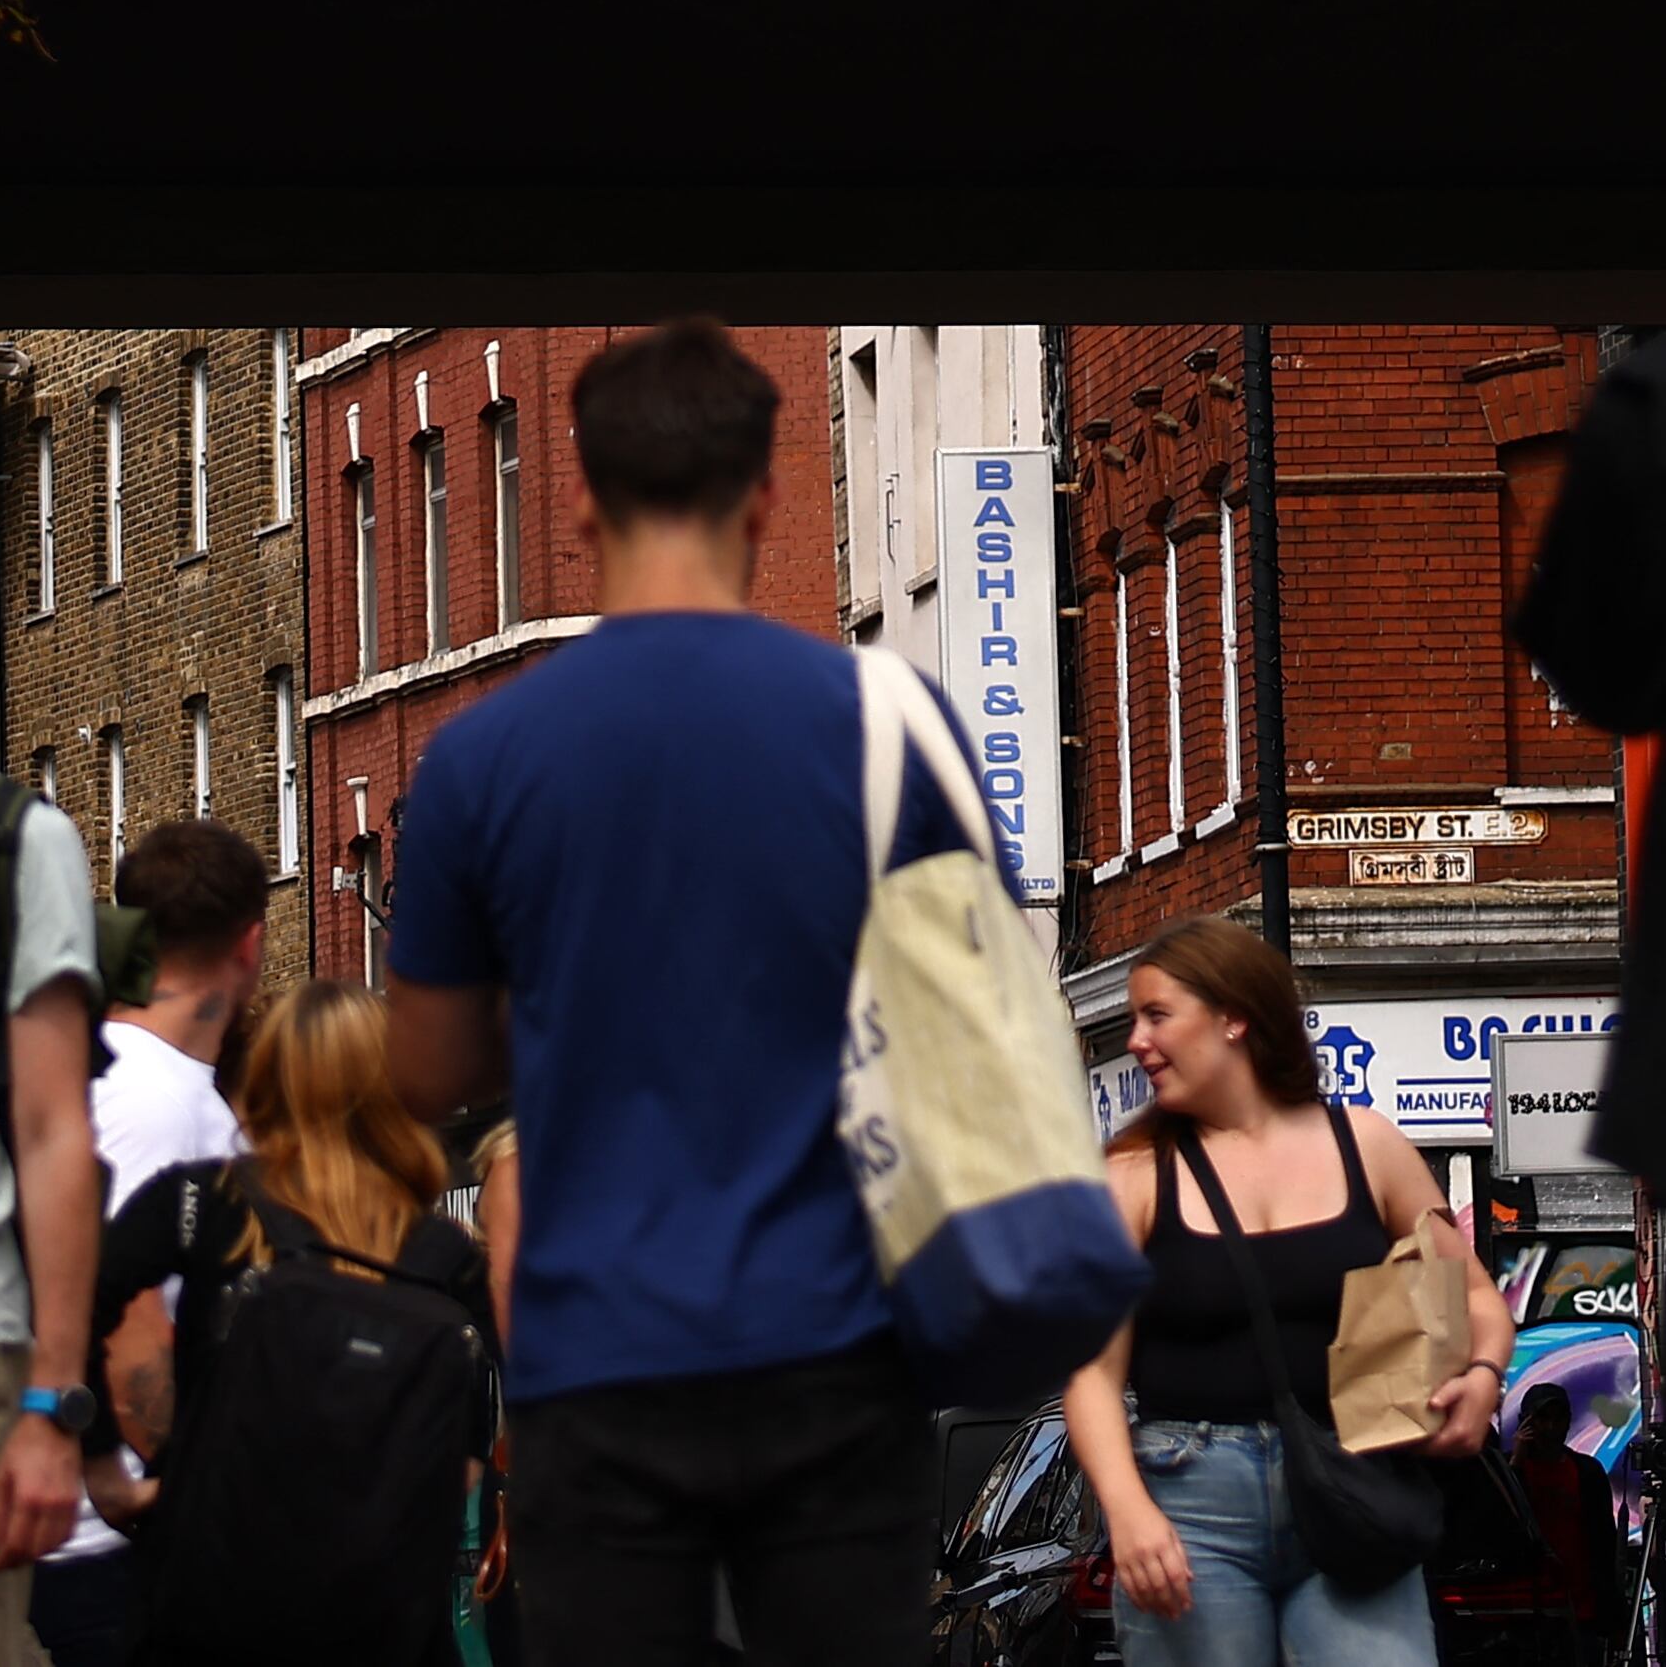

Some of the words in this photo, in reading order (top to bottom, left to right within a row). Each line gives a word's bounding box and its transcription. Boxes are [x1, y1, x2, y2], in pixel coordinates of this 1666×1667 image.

[973, 460, 1018, 667] BASHIR
[983, 684, 1025, 716] &
[983, 732, 1025, 872] SONS
[1296, 815, 1426, 841] GRIMSBY
[1436, 814, 1474, 839] ST.
